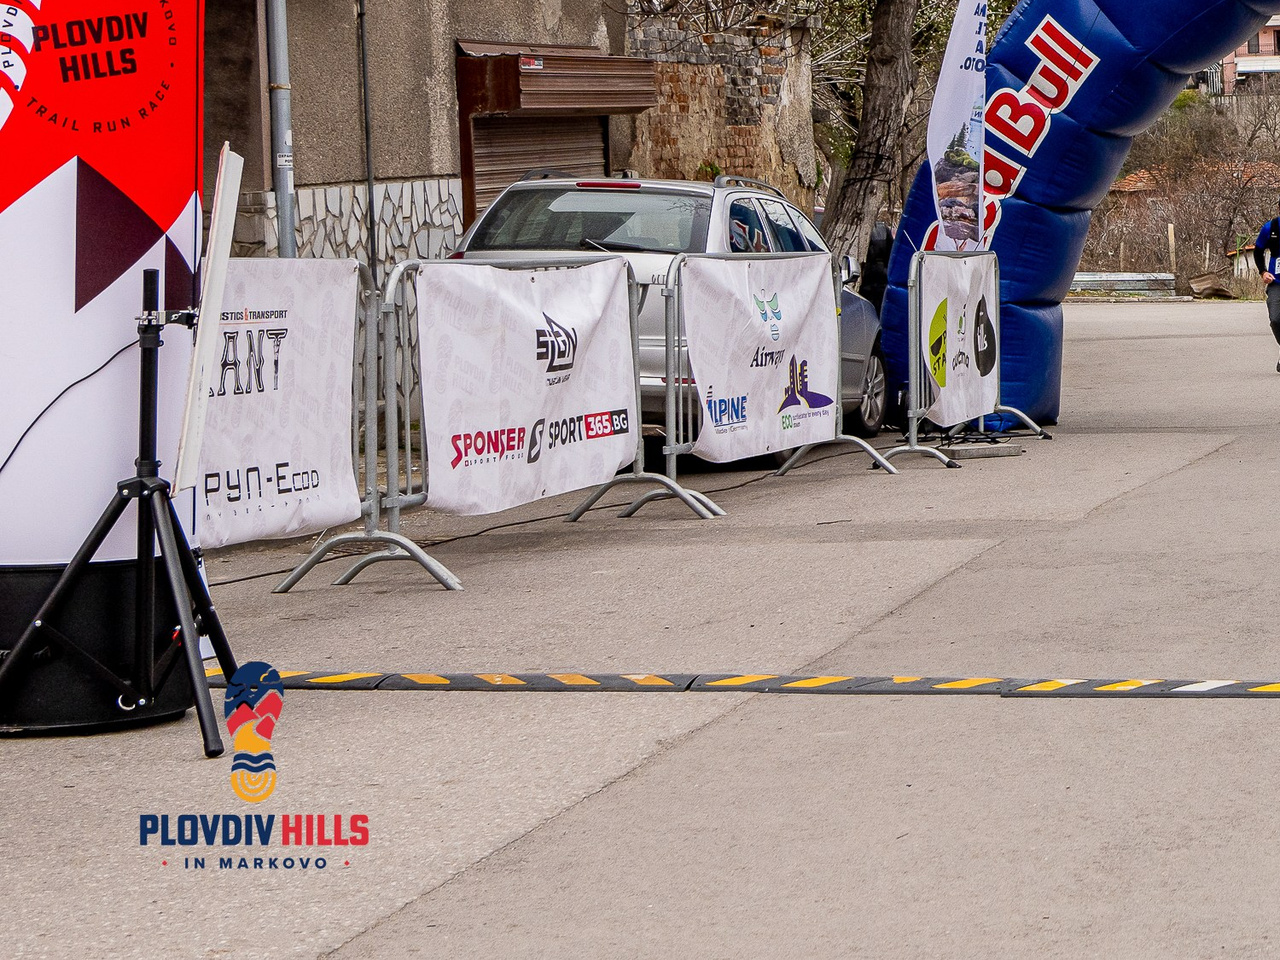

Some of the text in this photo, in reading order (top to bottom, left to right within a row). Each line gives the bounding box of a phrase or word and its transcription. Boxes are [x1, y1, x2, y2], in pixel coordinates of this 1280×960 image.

[32, 11, 149, 52] PLOVDIV
[59, 48, 138, 83] HILLS
[26, 80, 171, 134] TRAIL RUN RACE
[983, 17, 1096, 156] Bull
[249, 310, 288, 320] TRANSPORT
[782, 415, 793, 430] ECO
[450, 427, 526, 470] SPONSER
